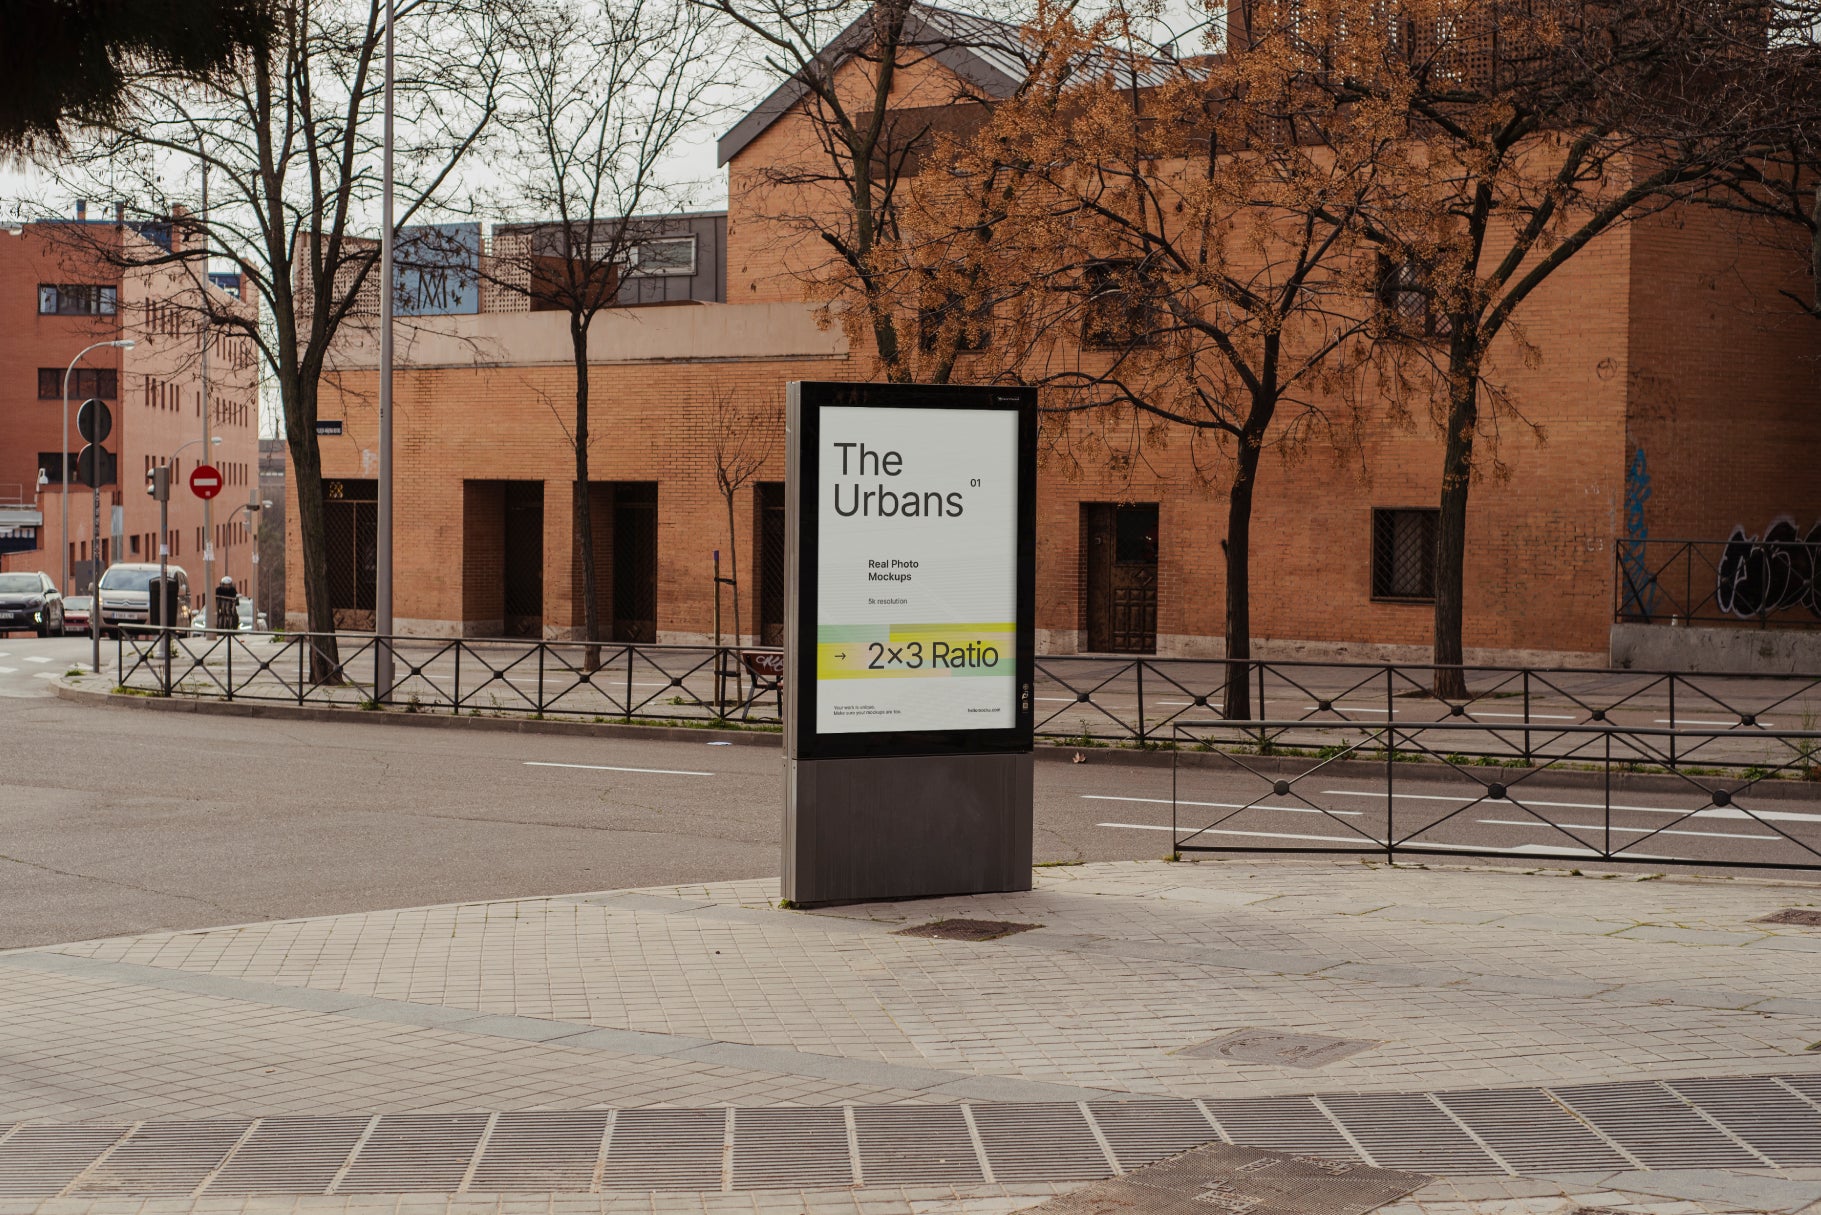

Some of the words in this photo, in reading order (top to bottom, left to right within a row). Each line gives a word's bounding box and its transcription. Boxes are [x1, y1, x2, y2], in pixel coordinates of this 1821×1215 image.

[833, 442, 903, 477] The
[970, 478, 981, 488] 01
[834, 483, 964, 518] Urbans
[868, 559, 889, 569] Real
[891, 559, 919, 569] Photo
[868, 572, 912, 582] Mockups
[932, 640, 999, 669] Ratio
